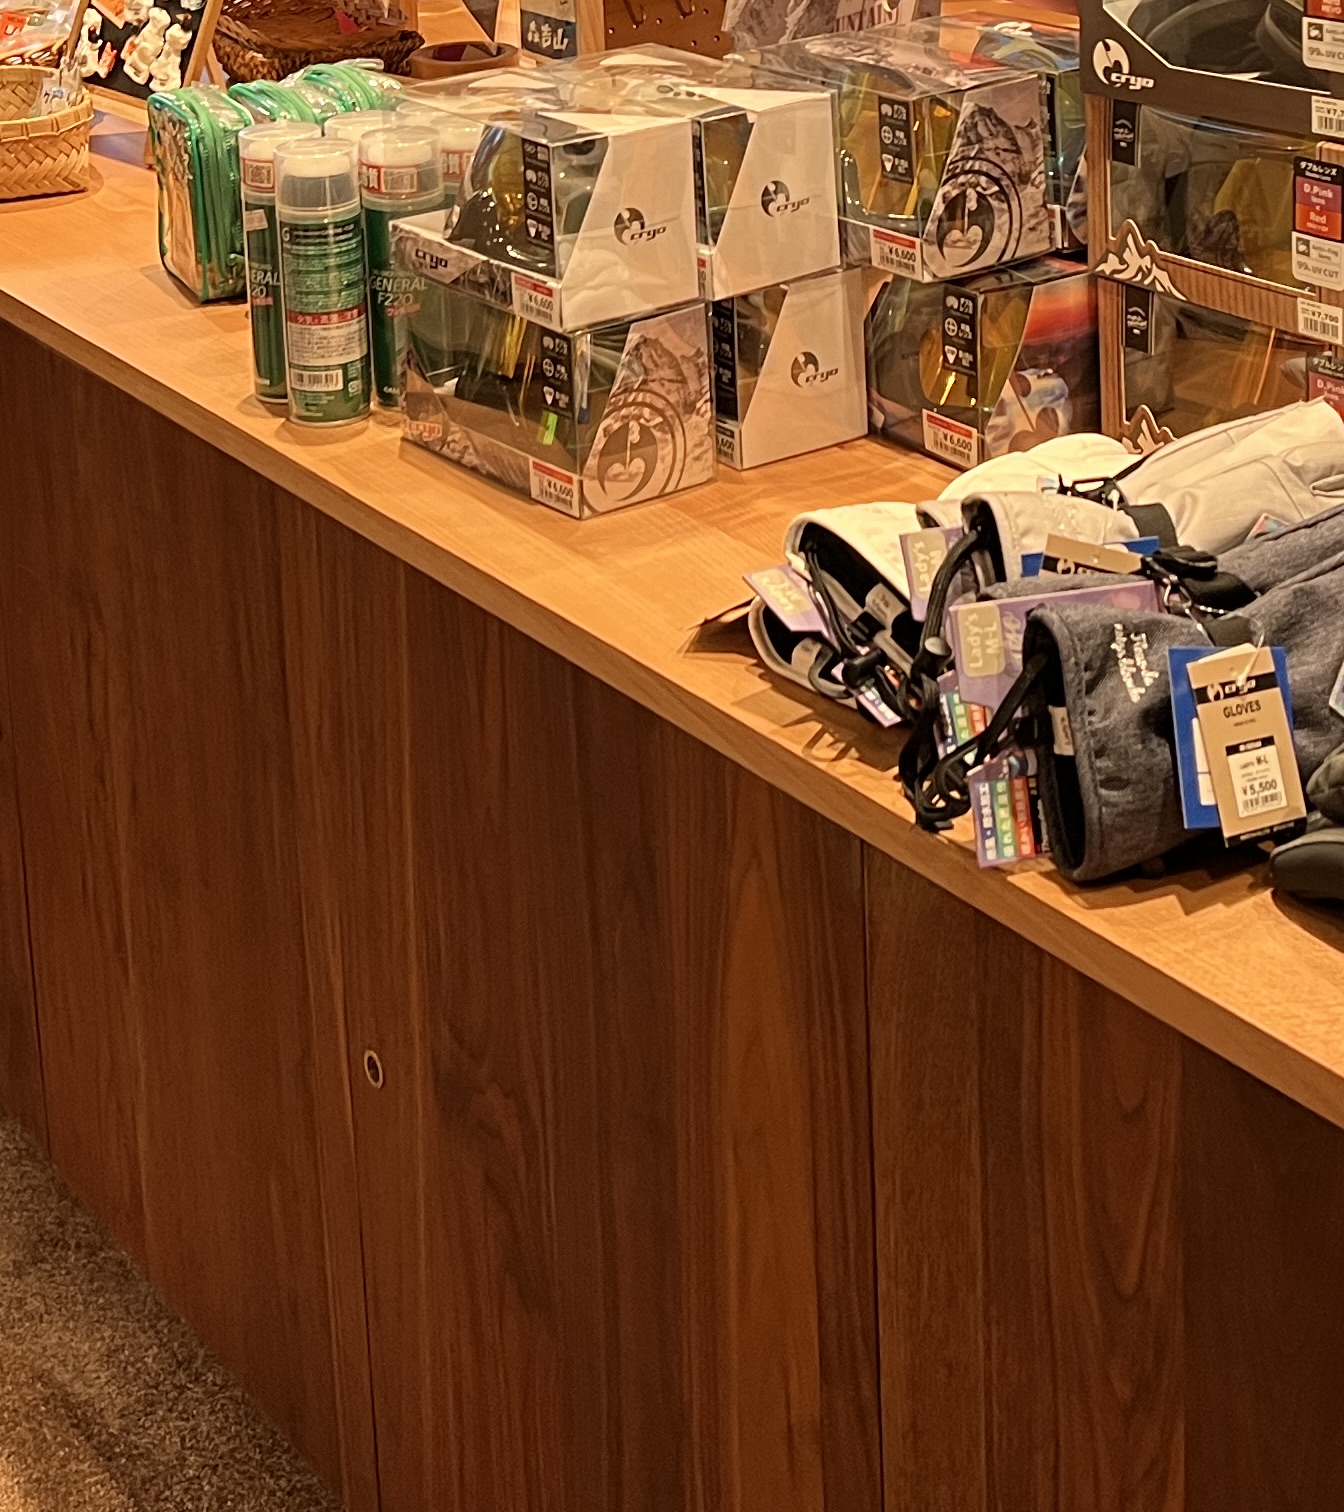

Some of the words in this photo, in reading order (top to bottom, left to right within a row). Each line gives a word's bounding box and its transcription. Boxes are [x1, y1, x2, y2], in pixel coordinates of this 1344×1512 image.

[1110, 71, 1155, 90] cryo
[776, 195, 811, 214] cryo
[630, 224, 667, 243] cryo
[415, 248, 448, 270] cryo
[804, 366, 839, 386] cryo
[967, 612, 983, 669] Lady's
[1222, 699, 1262, 719] GLOVES
[1241, 779, 1278, 797] ¥5,500
